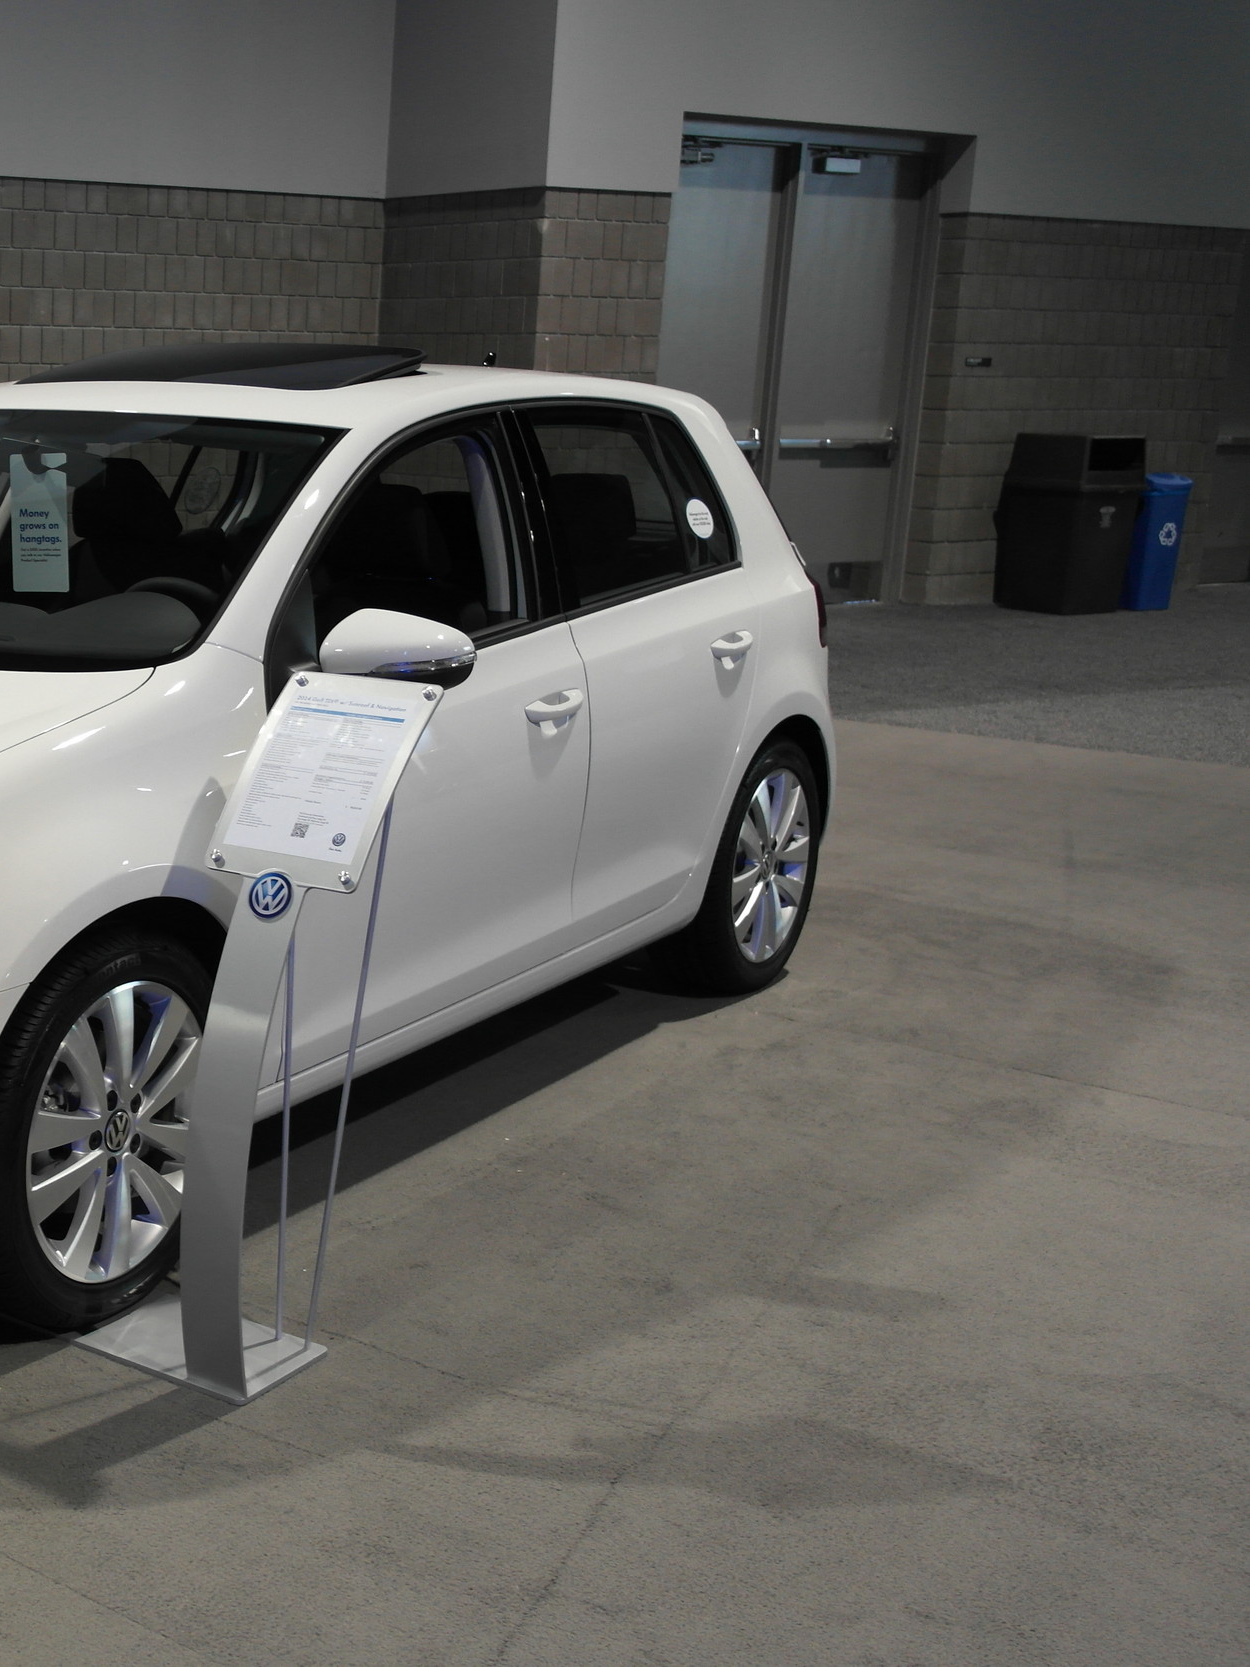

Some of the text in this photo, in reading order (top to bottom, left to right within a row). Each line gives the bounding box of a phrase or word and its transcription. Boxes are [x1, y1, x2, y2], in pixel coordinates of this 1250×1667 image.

[19, 508, 50, 519] Money
[19, 523, 47, 532] grows
[19, 533, 62, 545] hangtags.
[250, 873, 291, 918] VW
